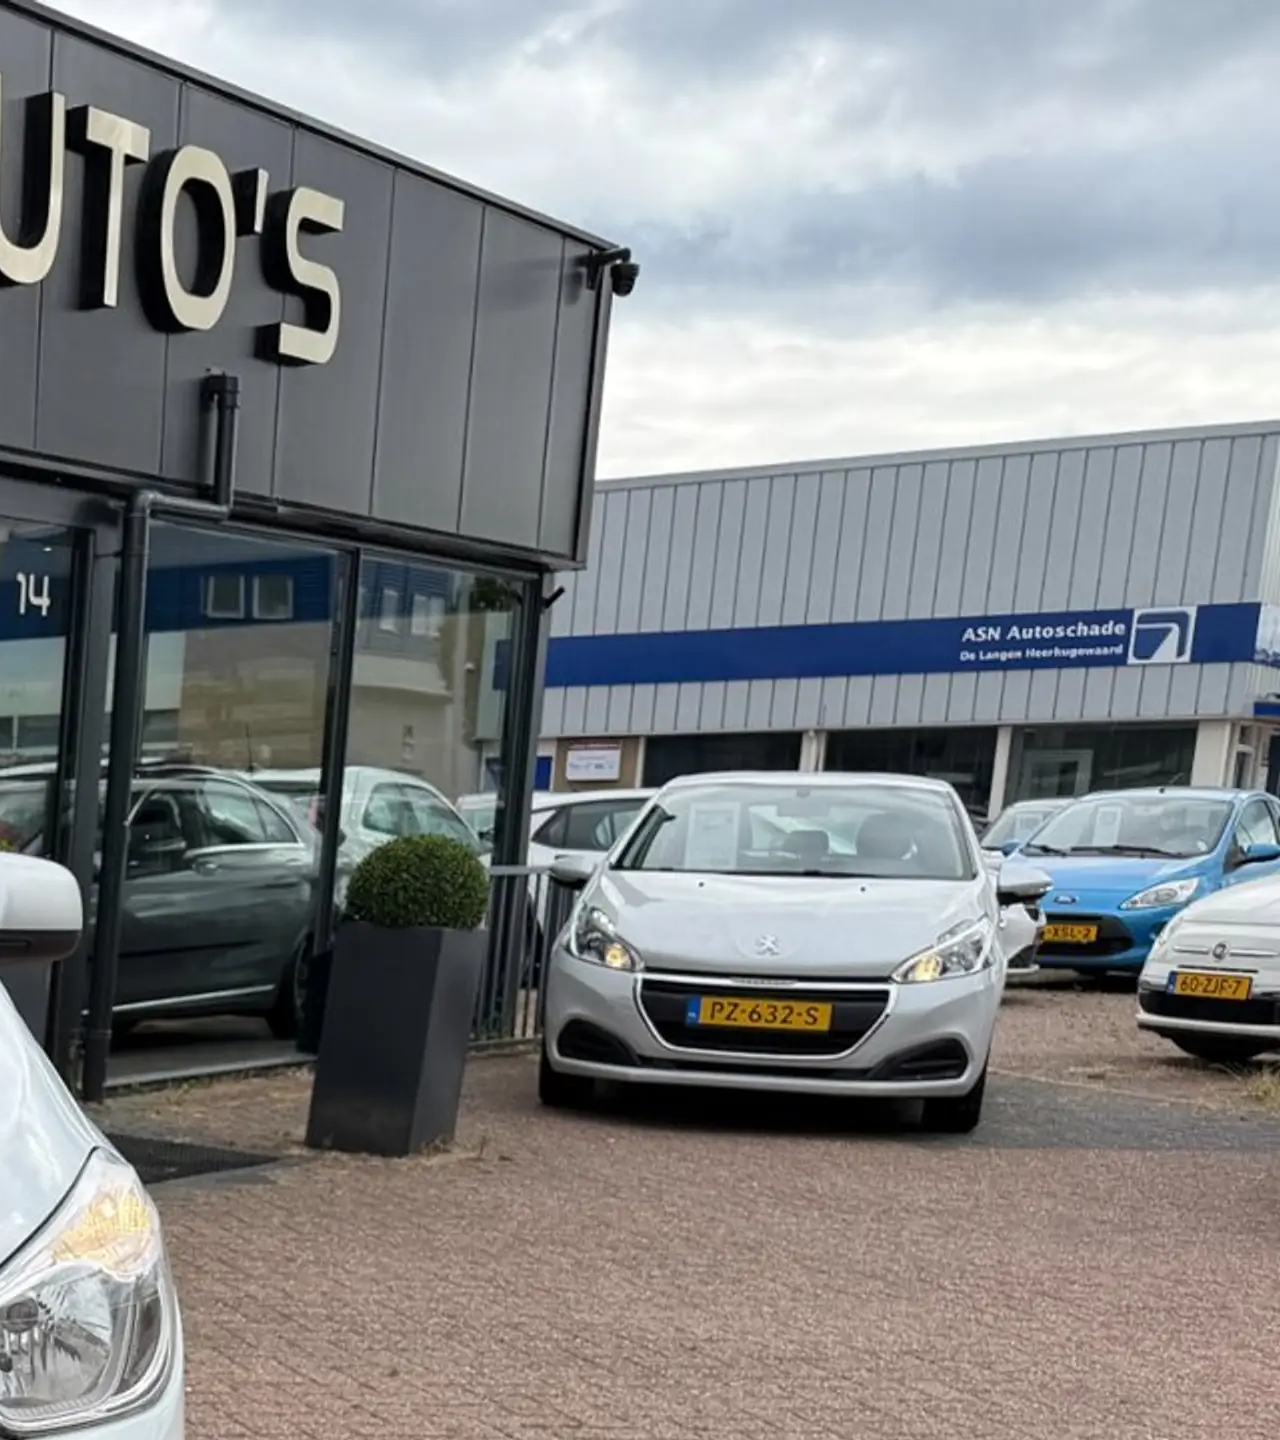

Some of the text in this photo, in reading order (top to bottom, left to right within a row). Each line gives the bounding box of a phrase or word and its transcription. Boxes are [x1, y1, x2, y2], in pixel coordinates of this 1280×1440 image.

[16, 572, 51, 617] 14
[962, 620, 1126, 642] ASN Autoschade
[959, 650, 976, 661] De
[979, 649, 1022, 662] Langen
[709, 1000, 820, 1026] PZ-632-S
